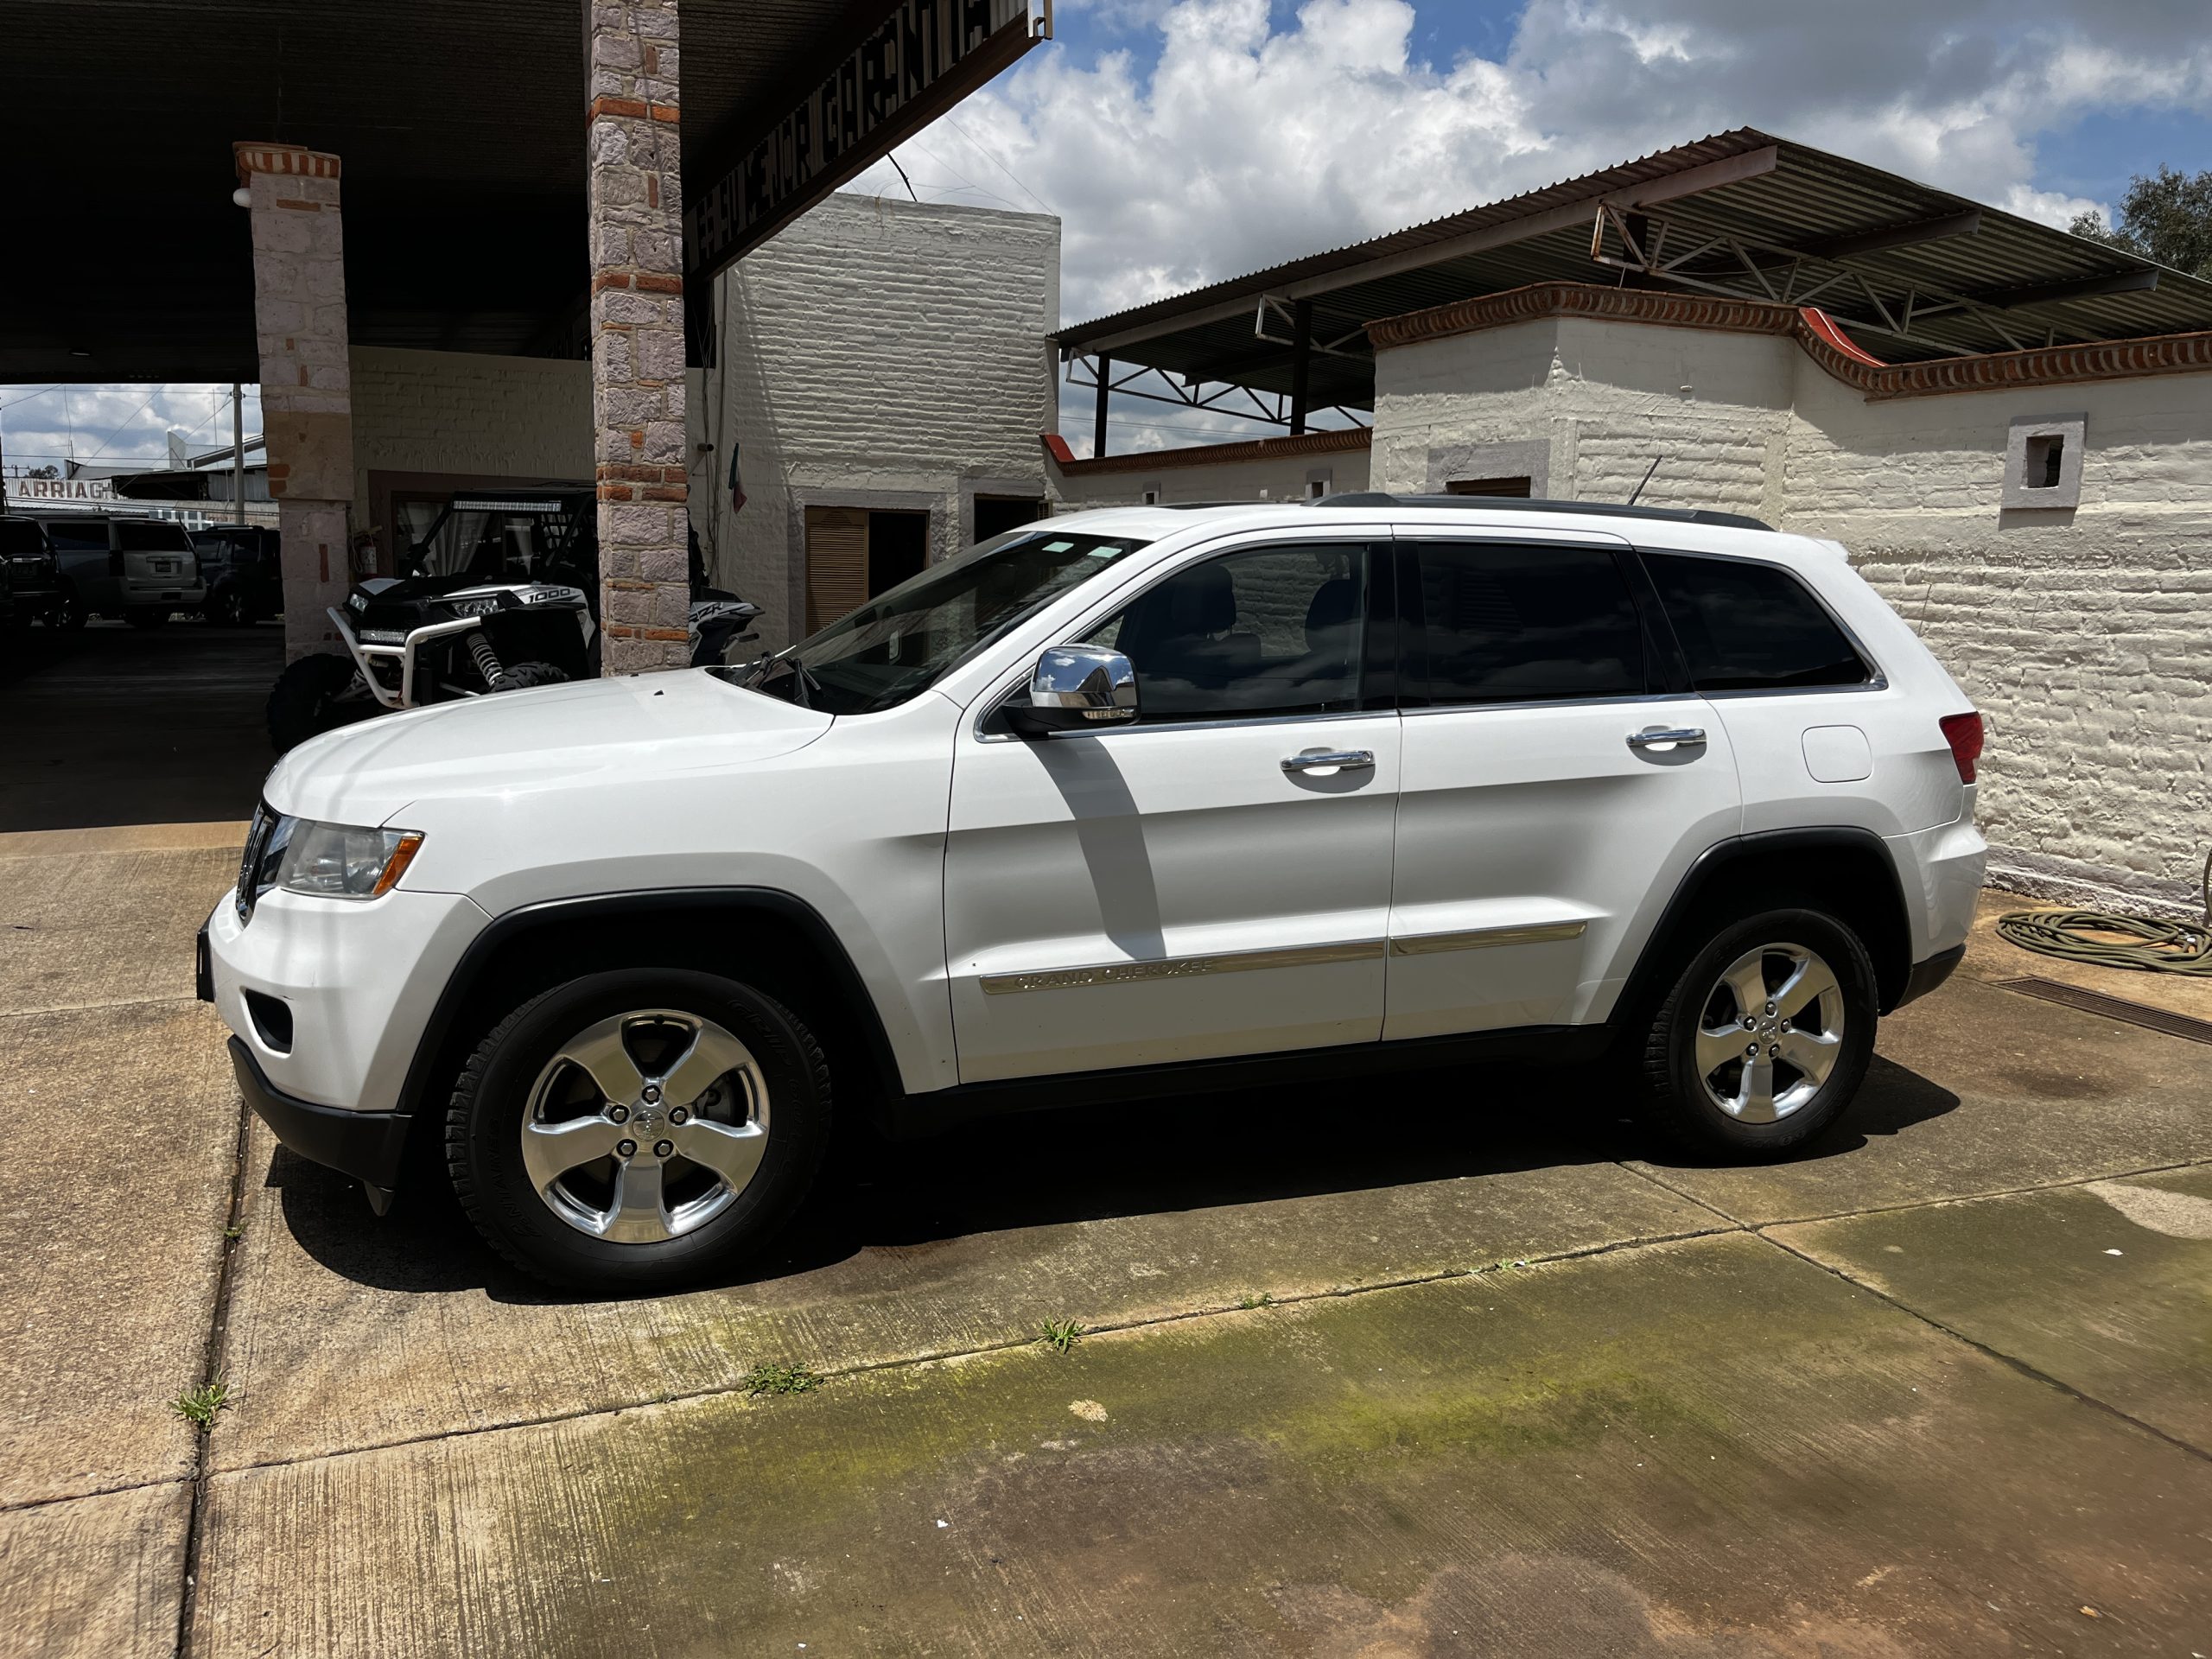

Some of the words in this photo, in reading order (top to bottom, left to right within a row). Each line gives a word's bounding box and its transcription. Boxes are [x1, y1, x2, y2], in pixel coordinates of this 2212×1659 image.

[529, 588, 571, 603] 1000
[1014, 969, 1094, 988] GRAND
[1102, 959, 1214, 981] CHEROKEE
